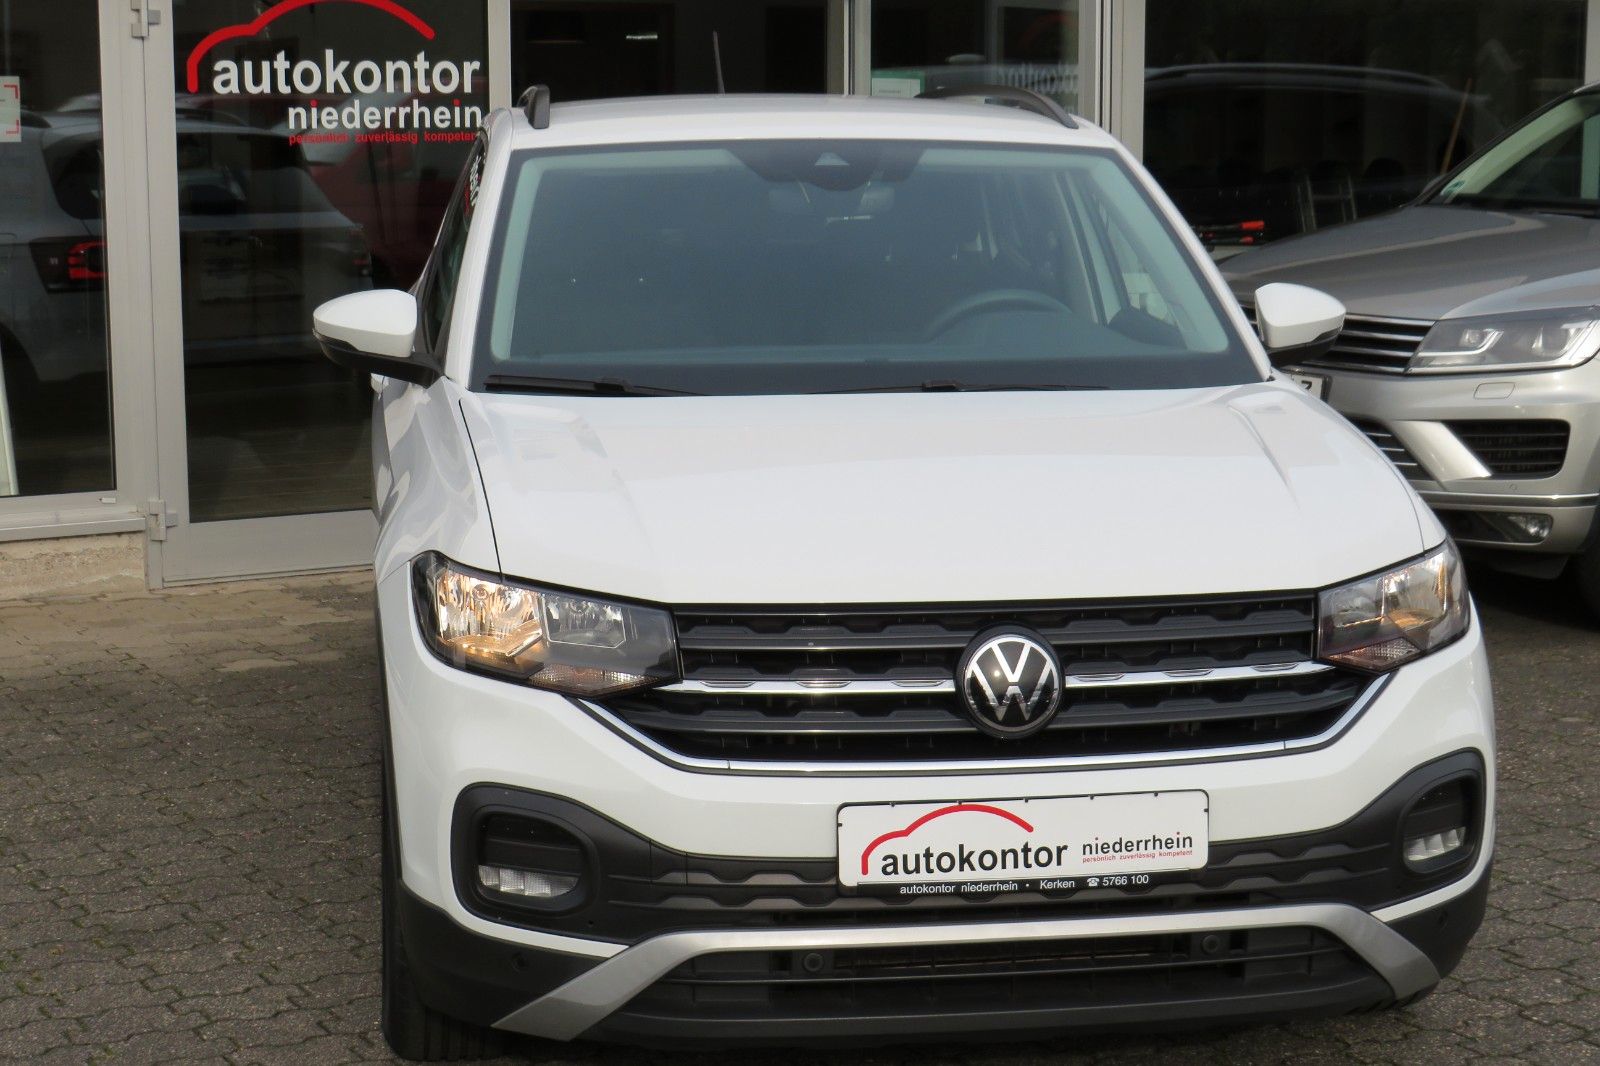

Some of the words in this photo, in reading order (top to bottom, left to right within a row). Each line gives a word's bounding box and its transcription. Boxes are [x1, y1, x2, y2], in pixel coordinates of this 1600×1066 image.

[212, 49, 480, 94] autokontor
[288, 99, 482, 129] niederrhein
[355, 130, 417, 144] zuverlässig
[881, 841, 1068, 876] autokontor
[1082, 832, 1193, 855] niederrhein
[1082, 854, 1116, 863] persönlich
[1119, 852, 1156, 861] zuverlässig
[900, 884, 955, 894] autokontor
[961, 881, 1018, 893] niederrhein
[1040, 880, 1075, 889] Kerken
[1102, 876, 1128, 886] 5766
[1131, 875, 1149, 884] 100
